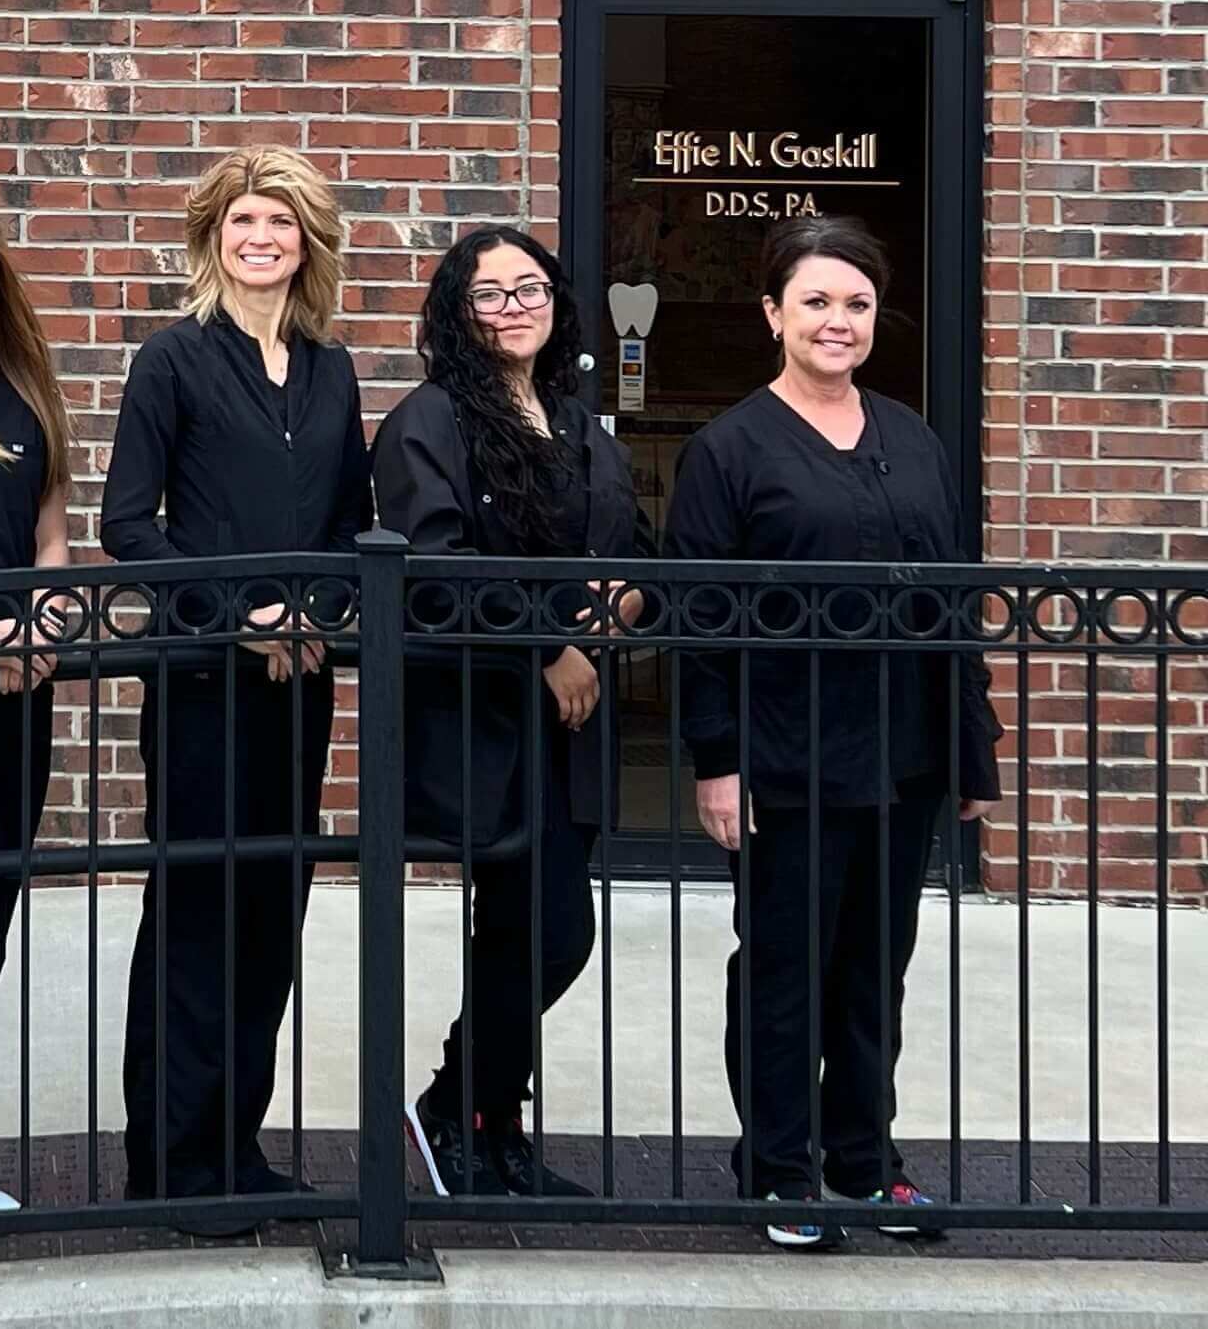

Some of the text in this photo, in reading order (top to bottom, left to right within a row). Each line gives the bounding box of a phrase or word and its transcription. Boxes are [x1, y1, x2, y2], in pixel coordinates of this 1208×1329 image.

[653, 130, 877, 174] Effie N. Gaskill
[706, 191, 824, 220] D.D.S., P.A.
